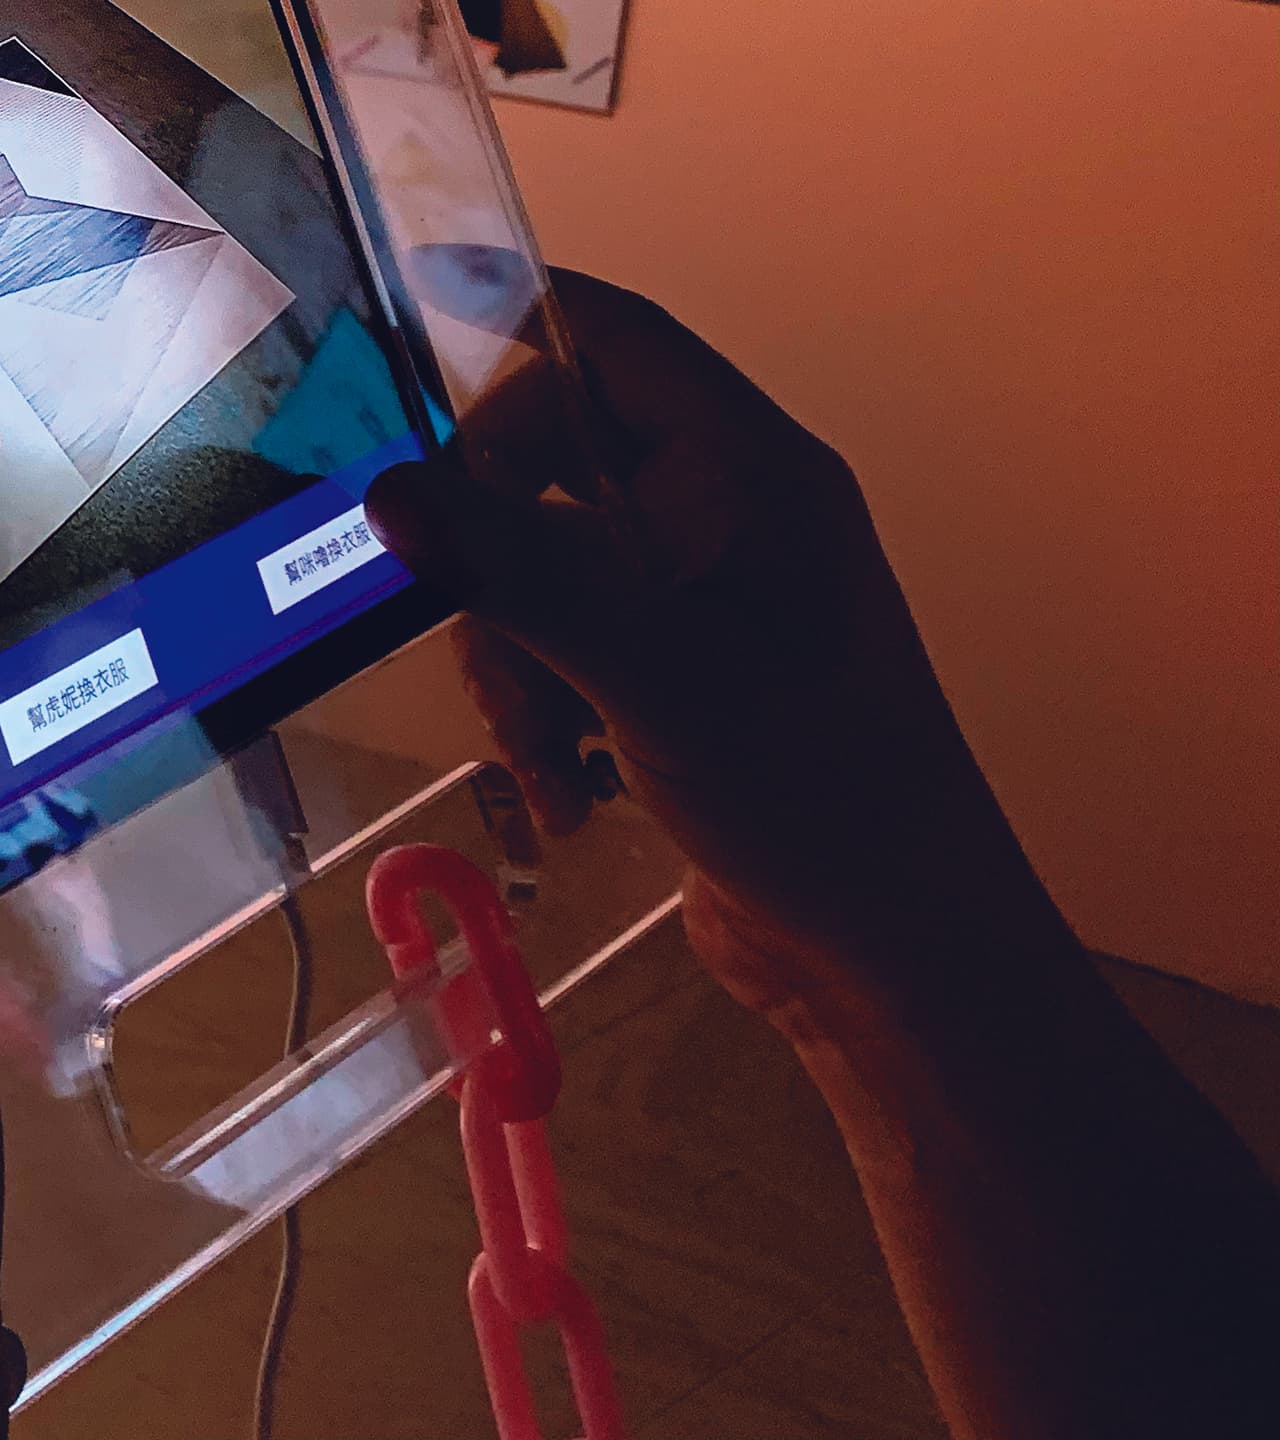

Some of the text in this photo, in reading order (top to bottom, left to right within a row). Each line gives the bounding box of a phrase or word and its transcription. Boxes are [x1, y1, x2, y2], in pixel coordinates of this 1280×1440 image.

[284, 521, 372, 585] 幫咪嚕換衣服
[26, 657, 130, 733] 幫虎妮換衣服
